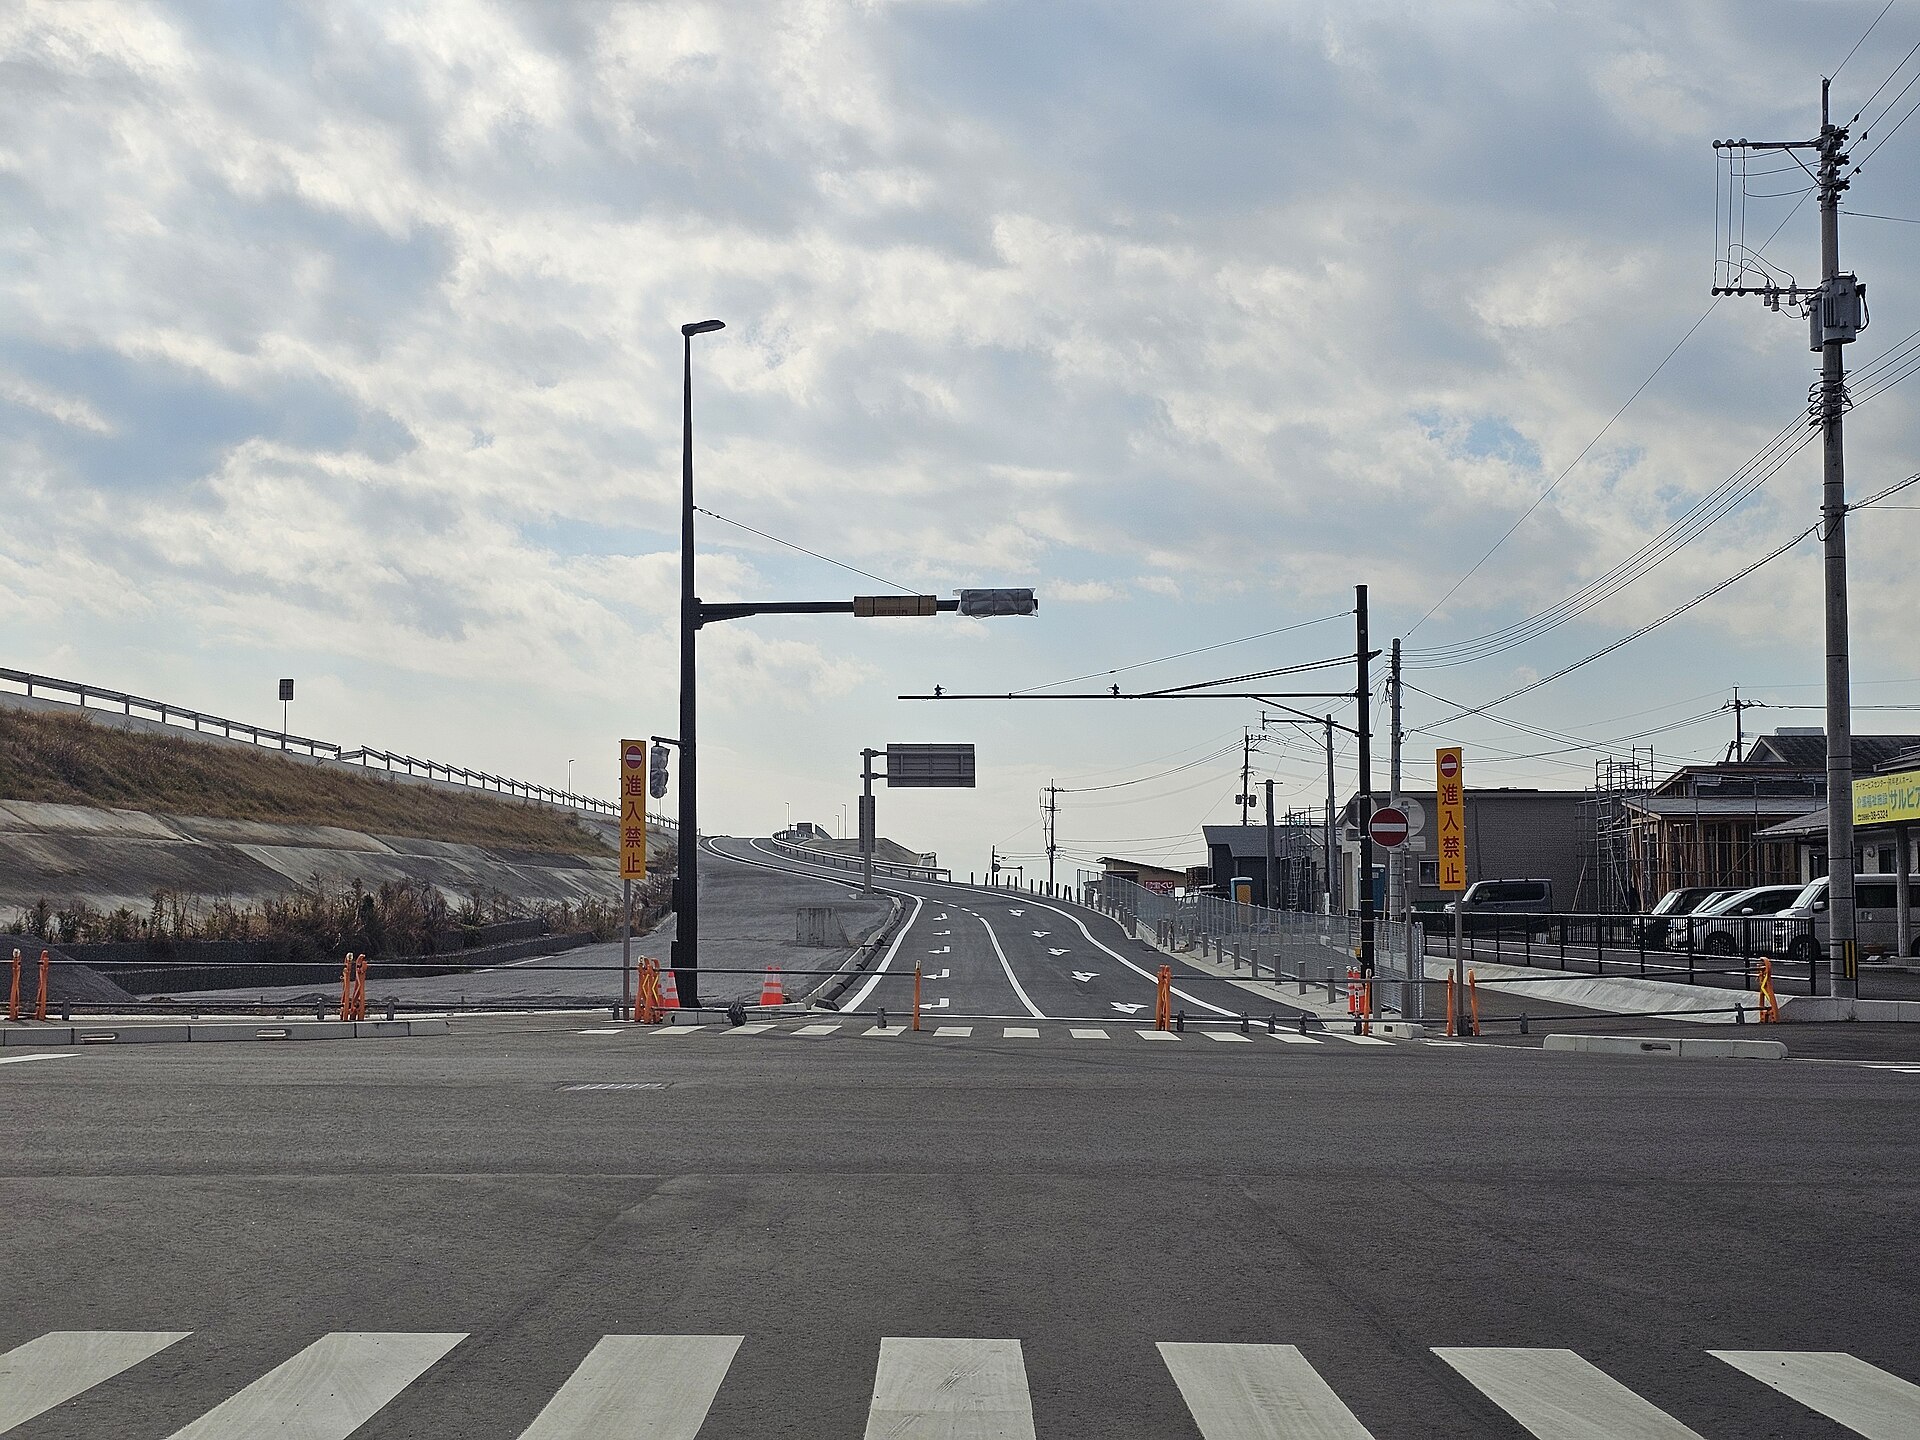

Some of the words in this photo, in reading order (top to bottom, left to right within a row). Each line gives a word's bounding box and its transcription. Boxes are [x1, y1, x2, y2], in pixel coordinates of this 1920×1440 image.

[625, 774, 642, 874] 進入禁止
[1441, 783, 1461, 885] 進入禁止
